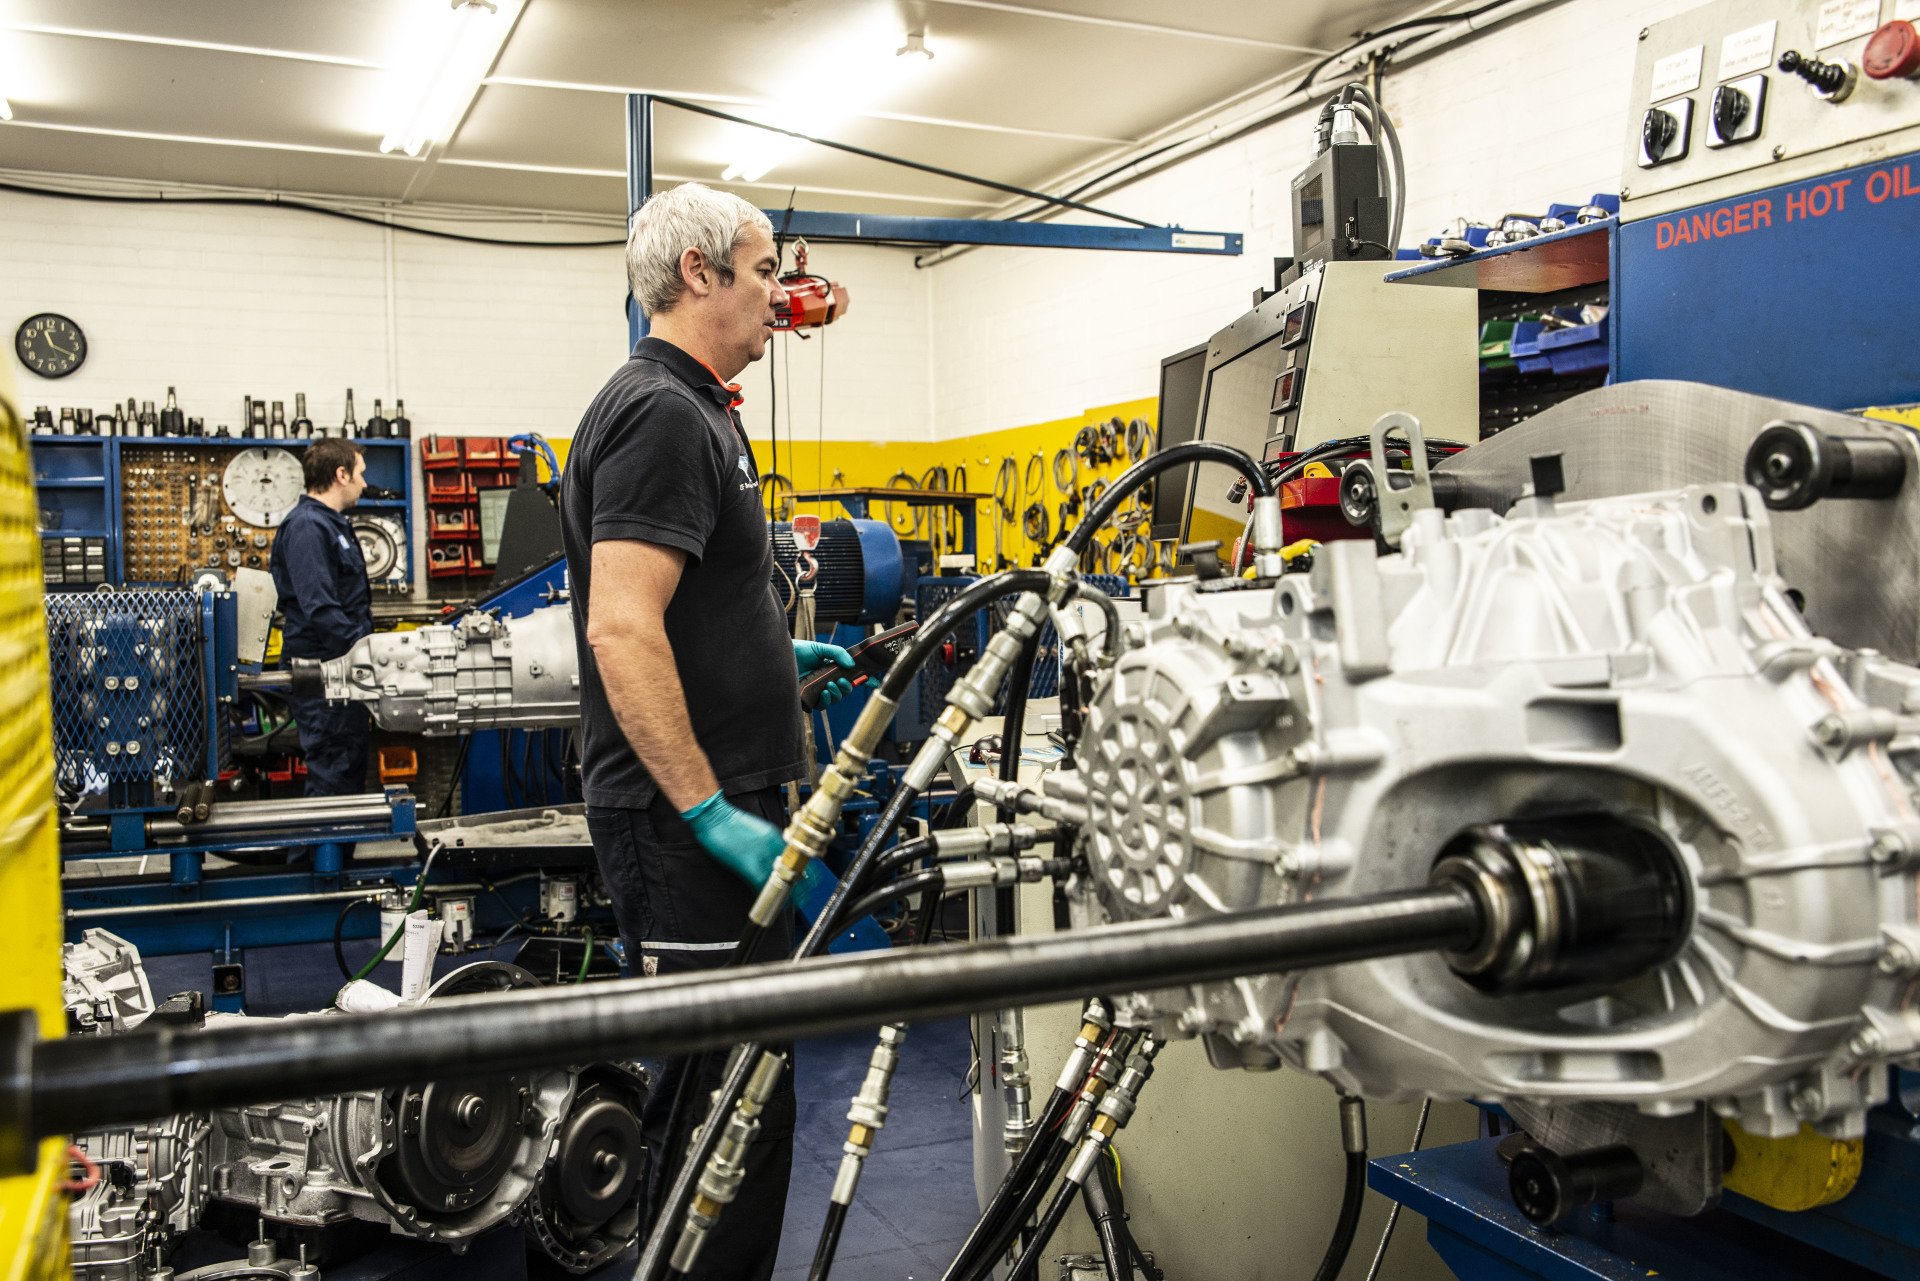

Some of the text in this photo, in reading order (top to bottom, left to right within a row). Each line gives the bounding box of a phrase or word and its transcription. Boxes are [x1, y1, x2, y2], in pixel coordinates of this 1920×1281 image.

[1656, 164, 1920, 250] DANGER HOT OIL
[36, 321, 43, 330] 11
[46, 318, 56, 328] 12
[61, 322, 65, 332] 1
[26, 328, 37, 338] 10
[69, 330, 76, 340] 2
[24, 340, 32, 350] 9
[74, 342, 80, 352] 3
[28, 352, 36, 360] 8
[37, 359, 44, 369] 7
[48, 362, 56, 372] 6
[60, 360, 67, 370] 5
